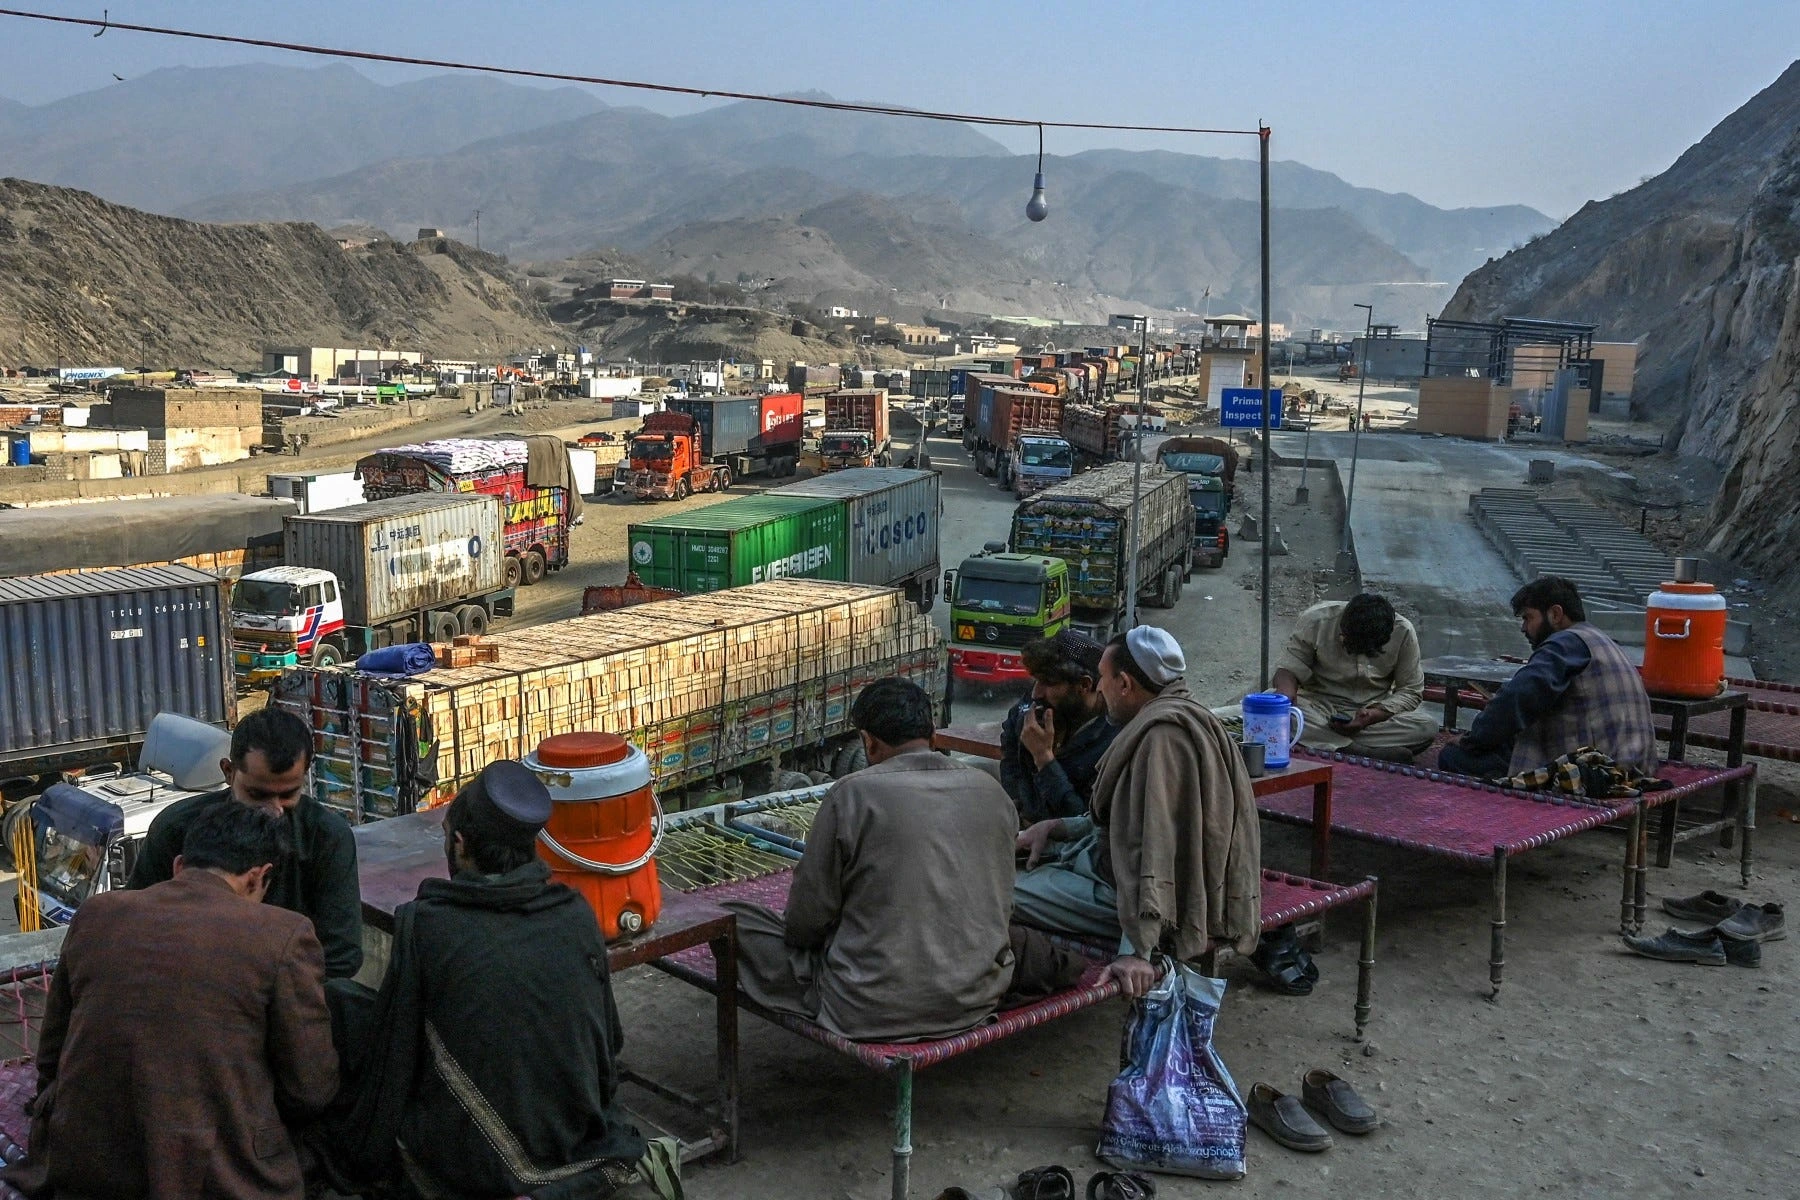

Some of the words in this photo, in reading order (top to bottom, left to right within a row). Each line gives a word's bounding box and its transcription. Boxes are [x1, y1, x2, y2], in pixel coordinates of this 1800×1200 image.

[64, 371, 103, 379] PHOENIX
[1232, 396, 1263, 405] Primar
[1225, 411, 1276, 421] Inspectn
[111, 608, 142, 618] TCLU
[961, 626, 975, 639] A
